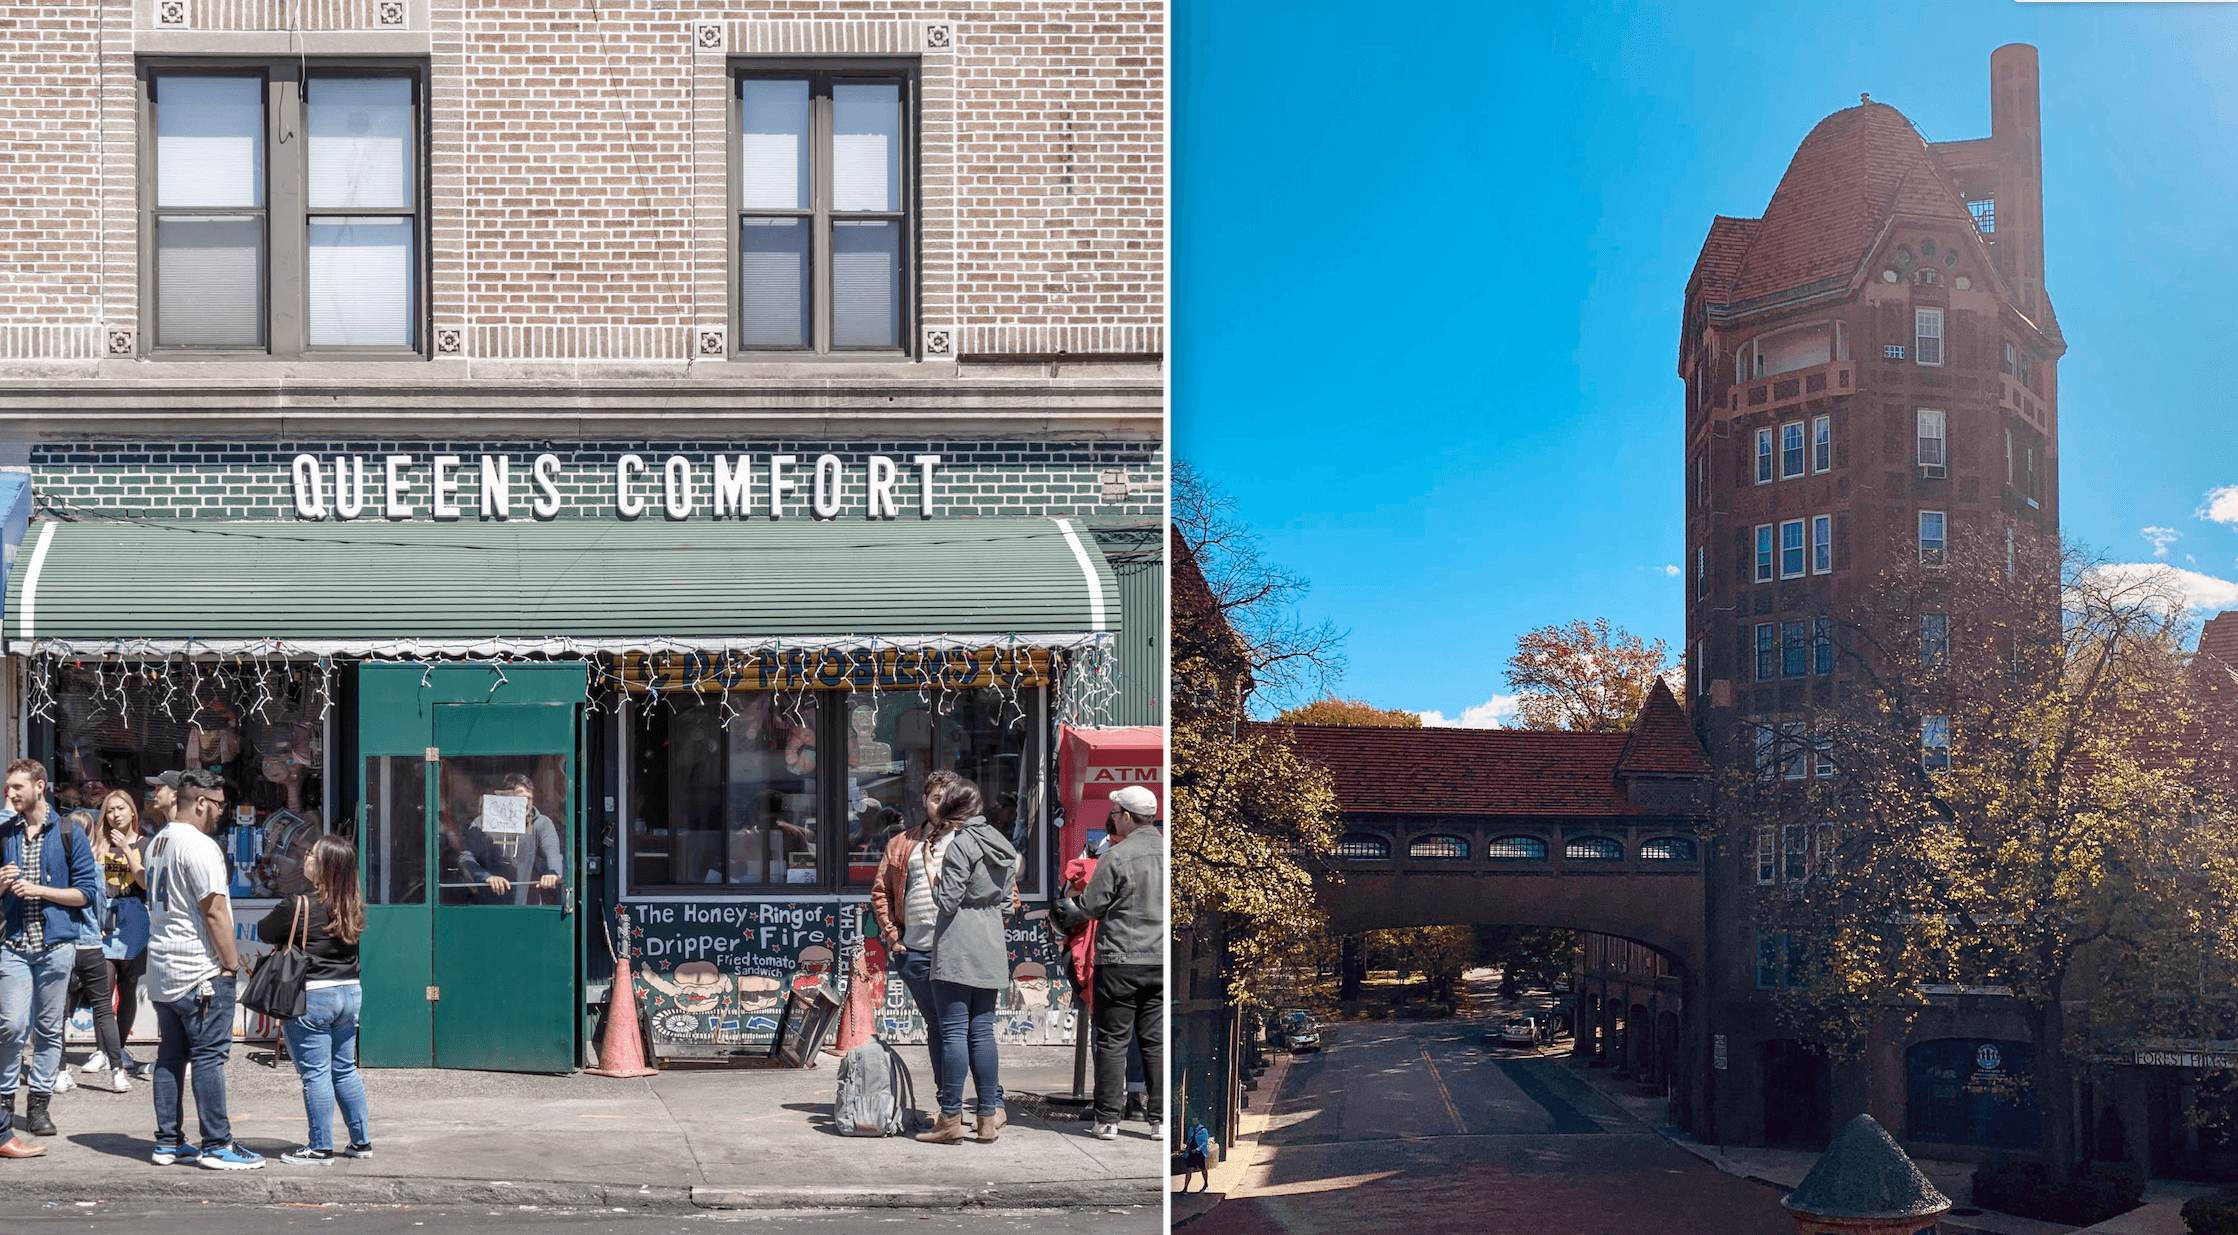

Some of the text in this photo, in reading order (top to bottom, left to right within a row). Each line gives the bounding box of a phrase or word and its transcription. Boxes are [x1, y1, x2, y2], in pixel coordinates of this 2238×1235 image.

[292, 453, 941, 519] QUEENS COMFORT
[759, 647, 978, 687] PROBLEMS
[1093, 767, 1158, 782] ATM
[490, 818, 518, 829] ONLY
[635, 904, 748, 928] The Honey
[759, 904, 824, 930] Ring of
[646, 933, 740, 959] Dripper
[759, 926, 825, 949] Fire
[716, 954, 796, 970] Fried tomato
[734, 965, 783, 978] Sandwich
[2136, 1052, 2227, 1069] FOREST HILLS
